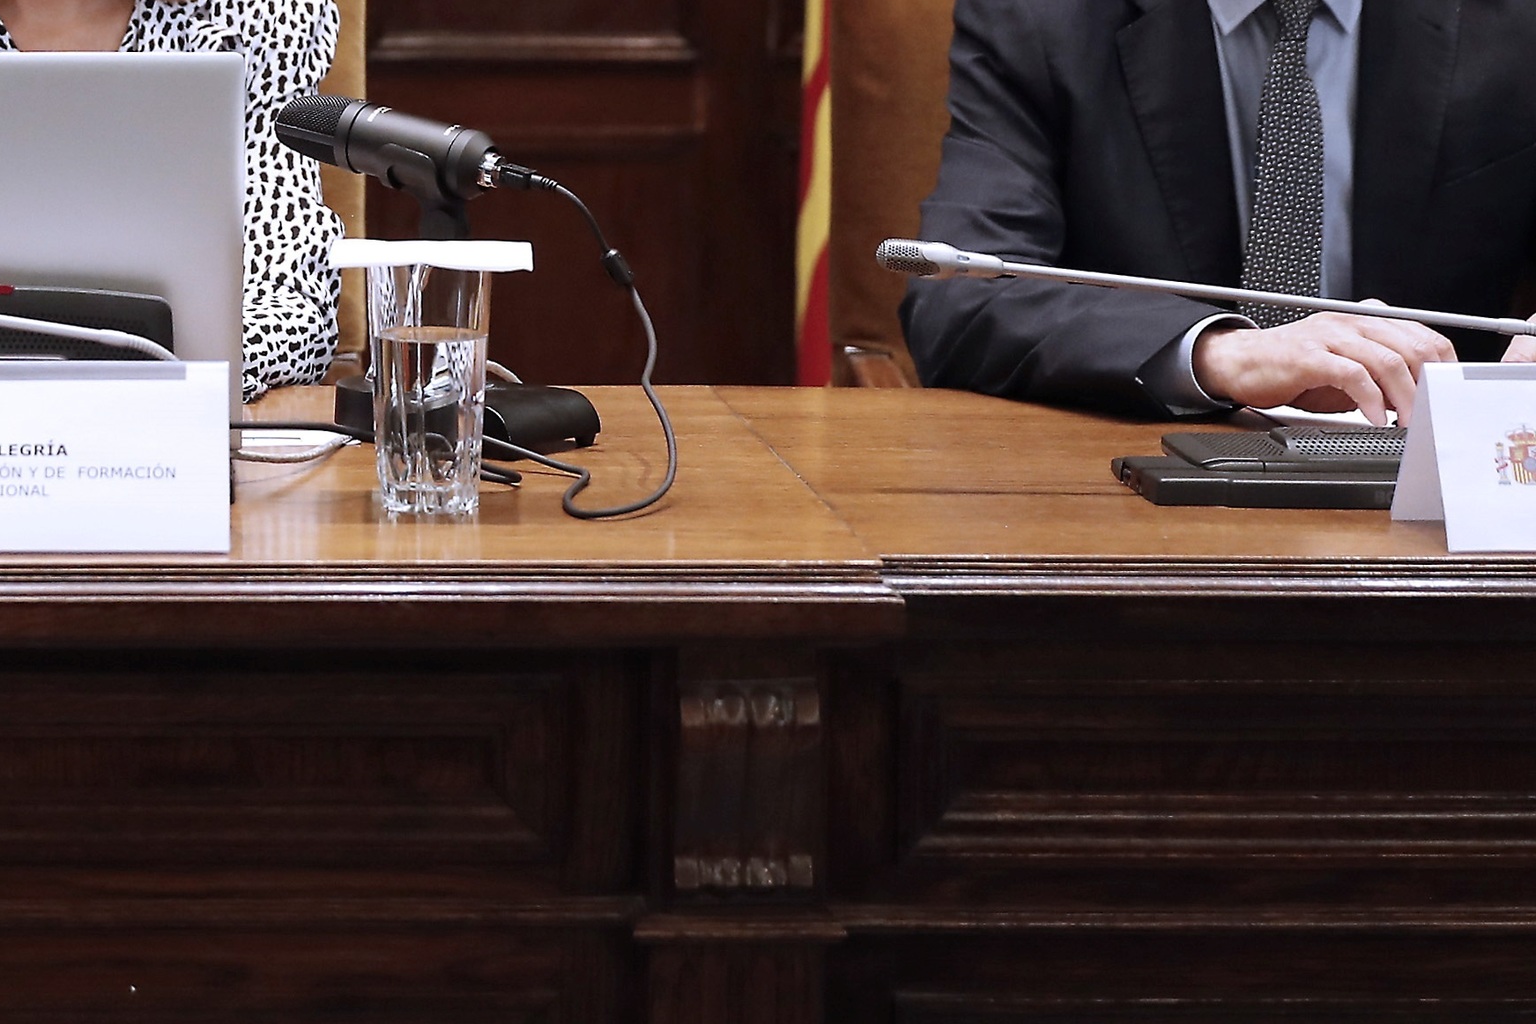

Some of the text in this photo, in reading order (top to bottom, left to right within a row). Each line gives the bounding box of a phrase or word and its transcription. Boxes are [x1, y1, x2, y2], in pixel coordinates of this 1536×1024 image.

[28, 466, 39, 478] Y
[45, 466, 65, 478] DE
[77, 463, 176, 478] FORMACIÓN
